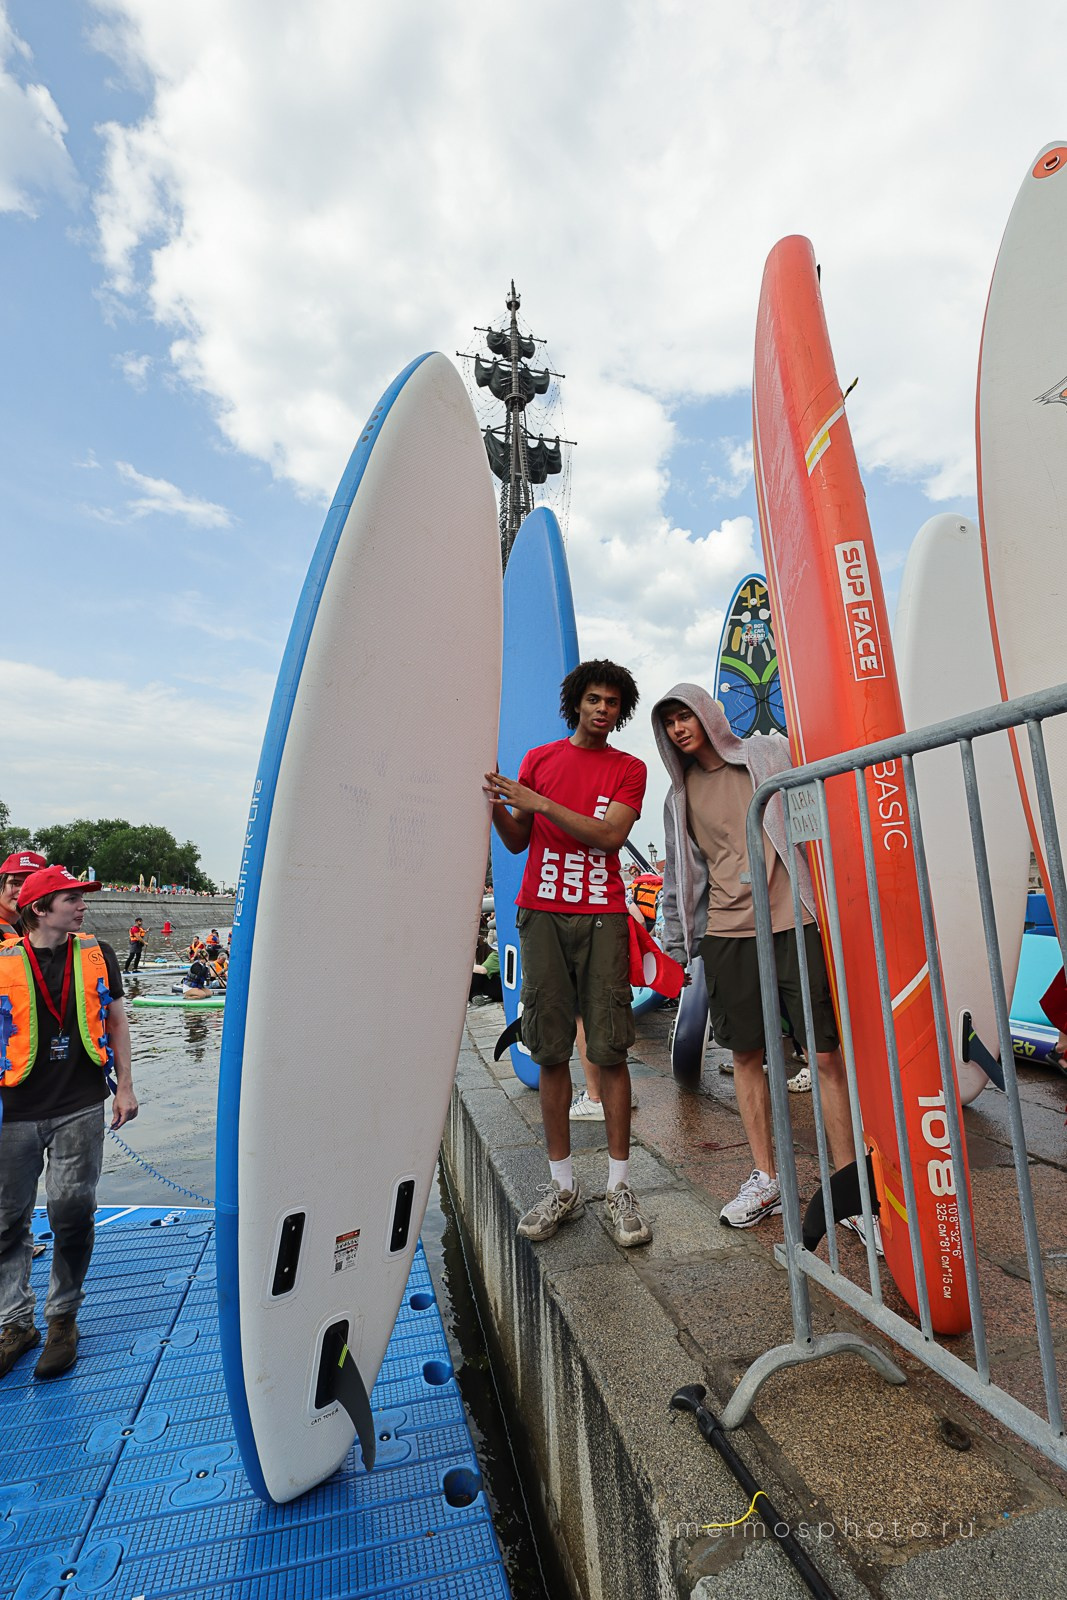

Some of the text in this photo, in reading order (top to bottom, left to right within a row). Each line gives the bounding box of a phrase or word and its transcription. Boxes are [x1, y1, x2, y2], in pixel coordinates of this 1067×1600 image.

[842, 547, 878, 671] SUP FACE
[872, 759, 908, 851] BASIC
[537, 848, 560, 900] ВОТ
[562, 850, 586, 903] САП,
[1012, 1038, 1037, 1056] 42
[935, 1202, 948, 1222] 325
